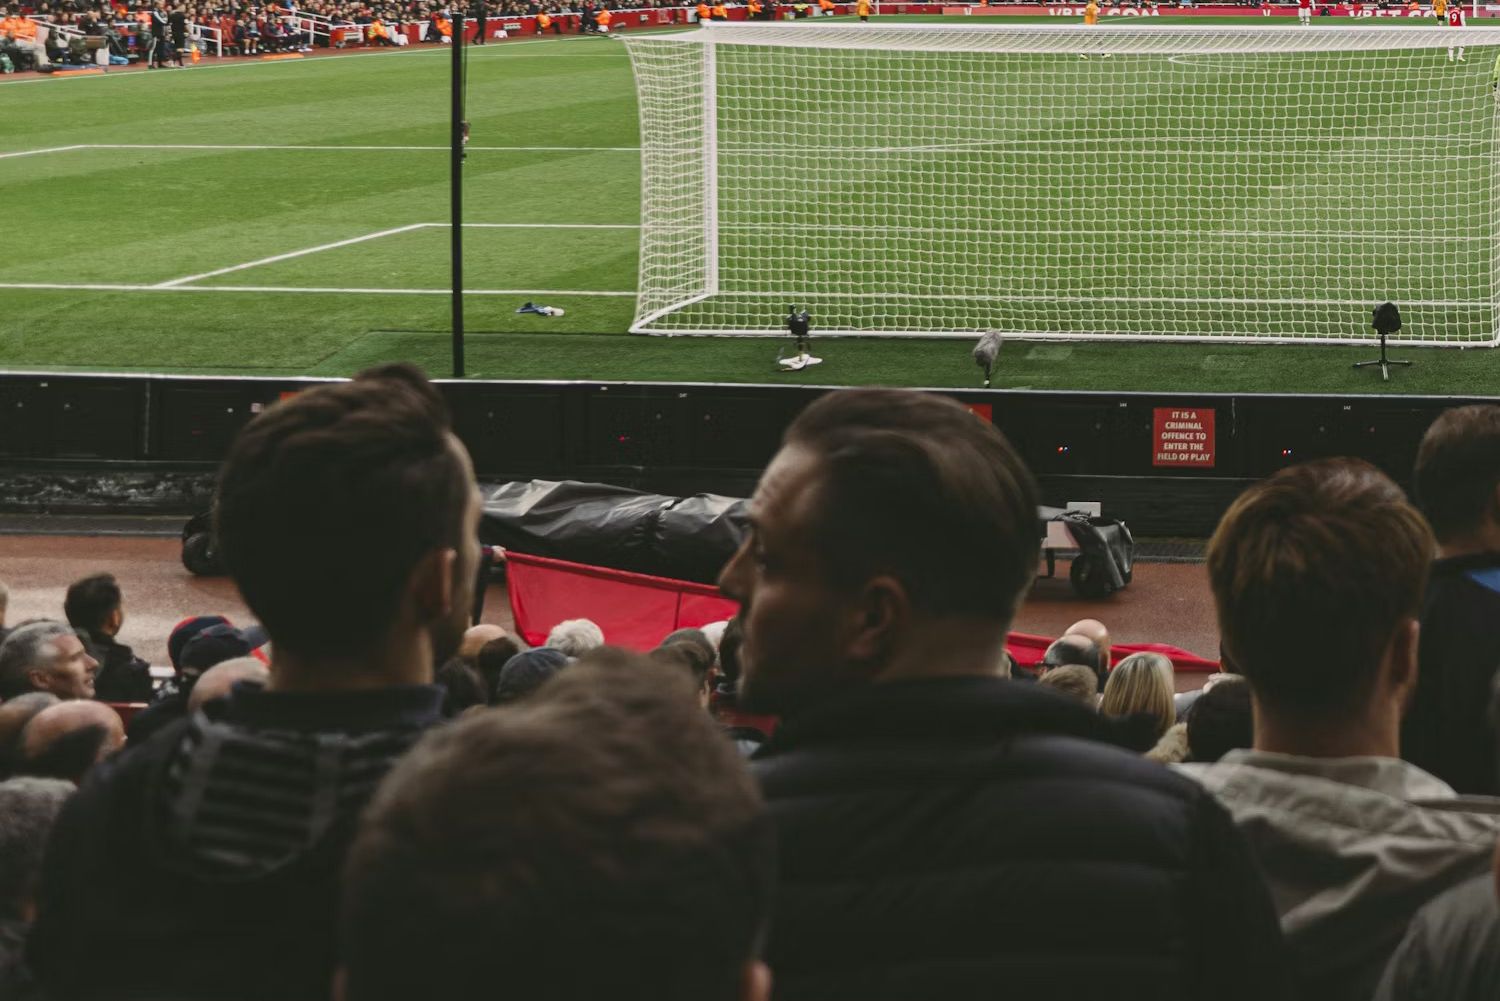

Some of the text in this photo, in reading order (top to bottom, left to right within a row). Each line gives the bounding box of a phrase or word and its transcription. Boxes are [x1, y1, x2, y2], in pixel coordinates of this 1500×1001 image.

[1171, 411, 1197, 419] IT IS A
[1165, 422, 1203, 430] CRIMINAL
[1161, 432, 1207, 440] OFFENCE TO
[1163, 442, 1204, 450] ENTER THE
[1157, 452, 1177, 460] FIELD
[1190, 453, 1211, 461] PLAY
